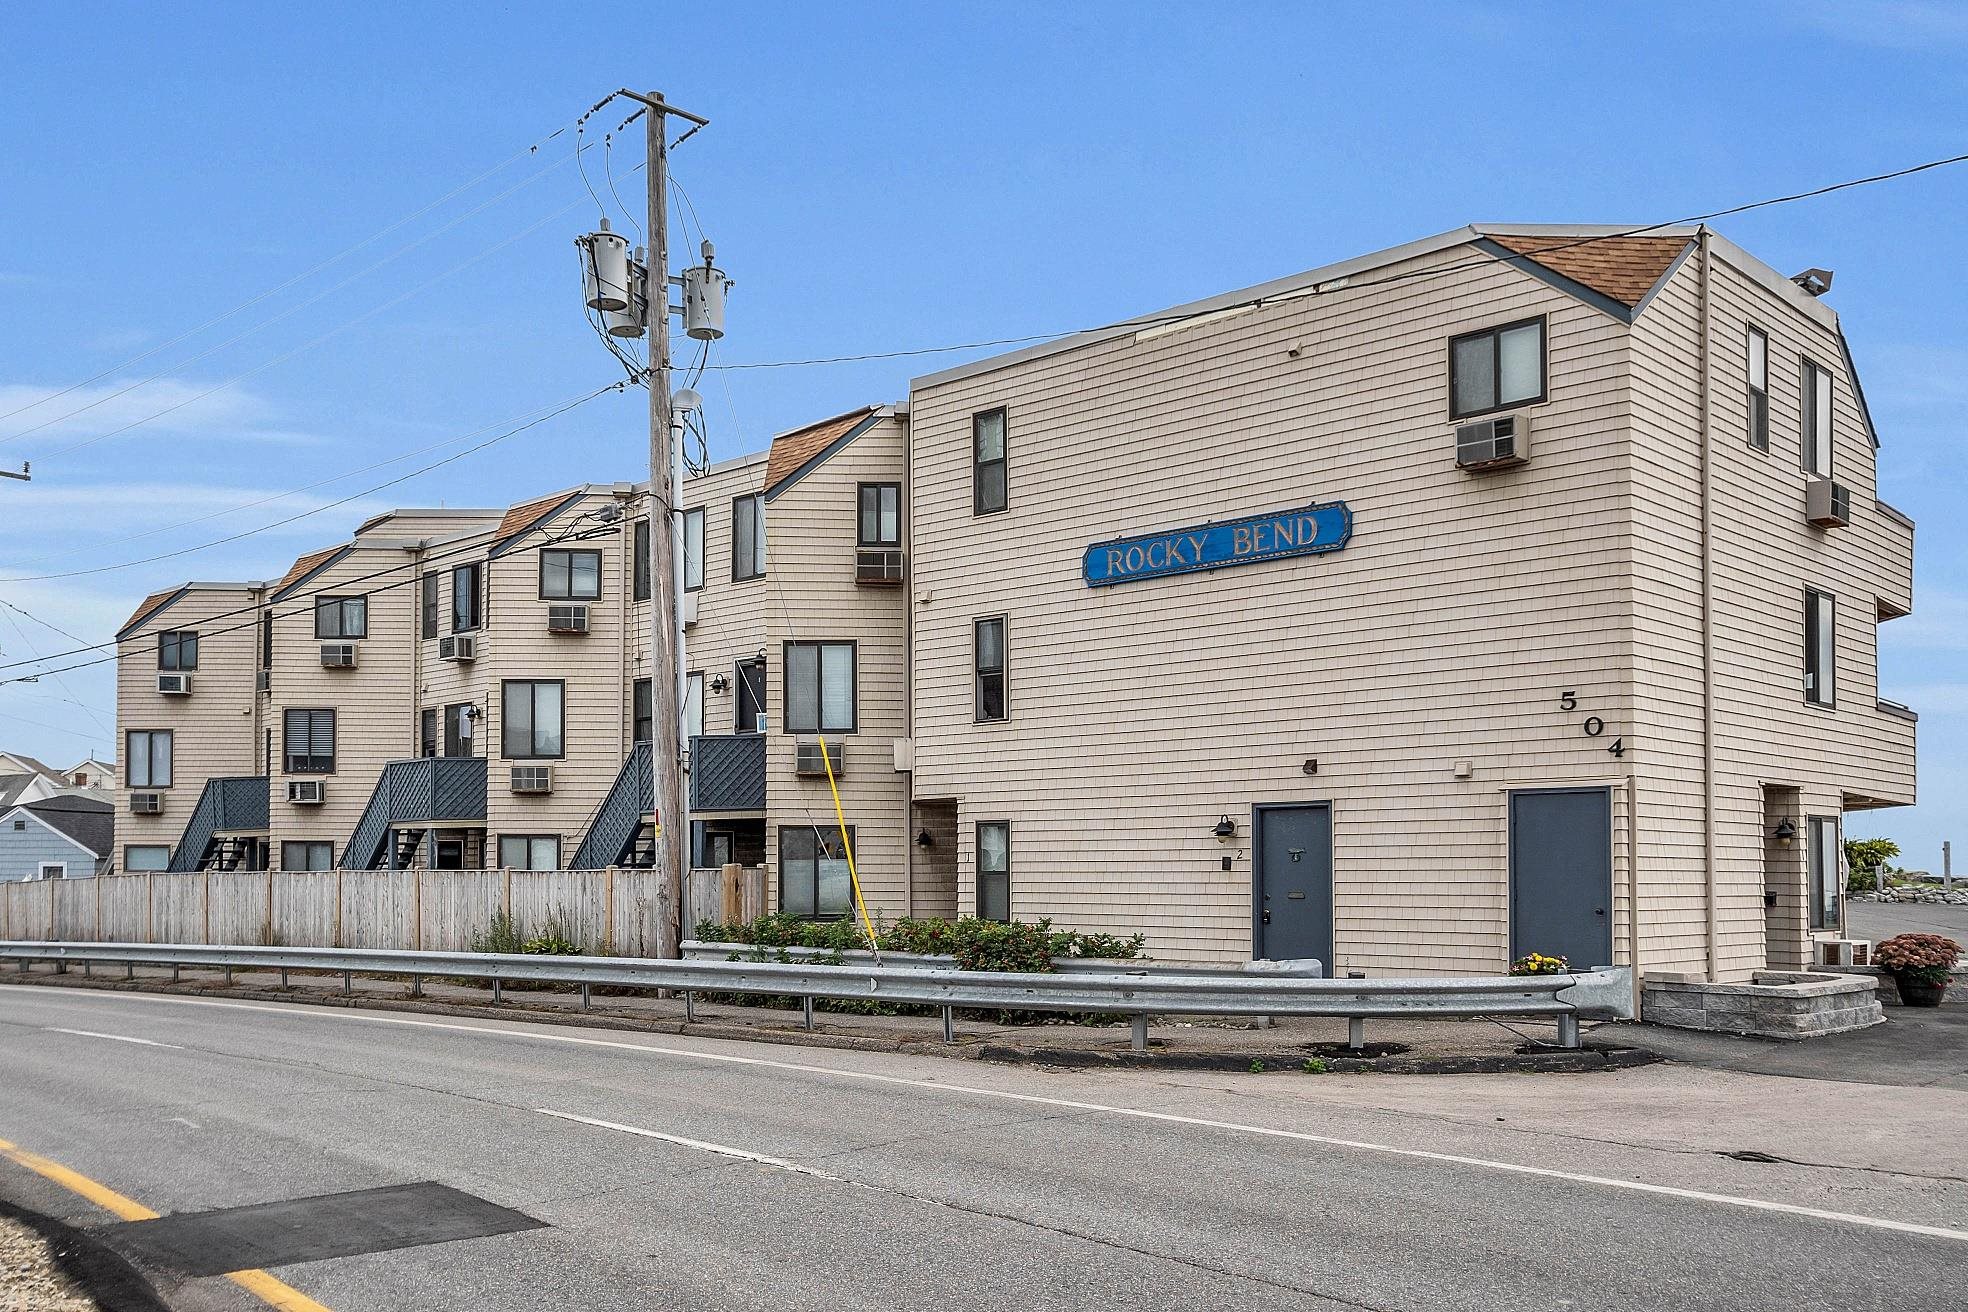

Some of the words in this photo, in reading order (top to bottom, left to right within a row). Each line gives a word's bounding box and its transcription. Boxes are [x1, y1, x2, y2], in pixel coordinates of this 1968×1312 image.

[1106, 533, 1209, 576] ROCKY
[1232, 515, 1319, 556] BEND
[1236, 849, 1243, 860] 2
